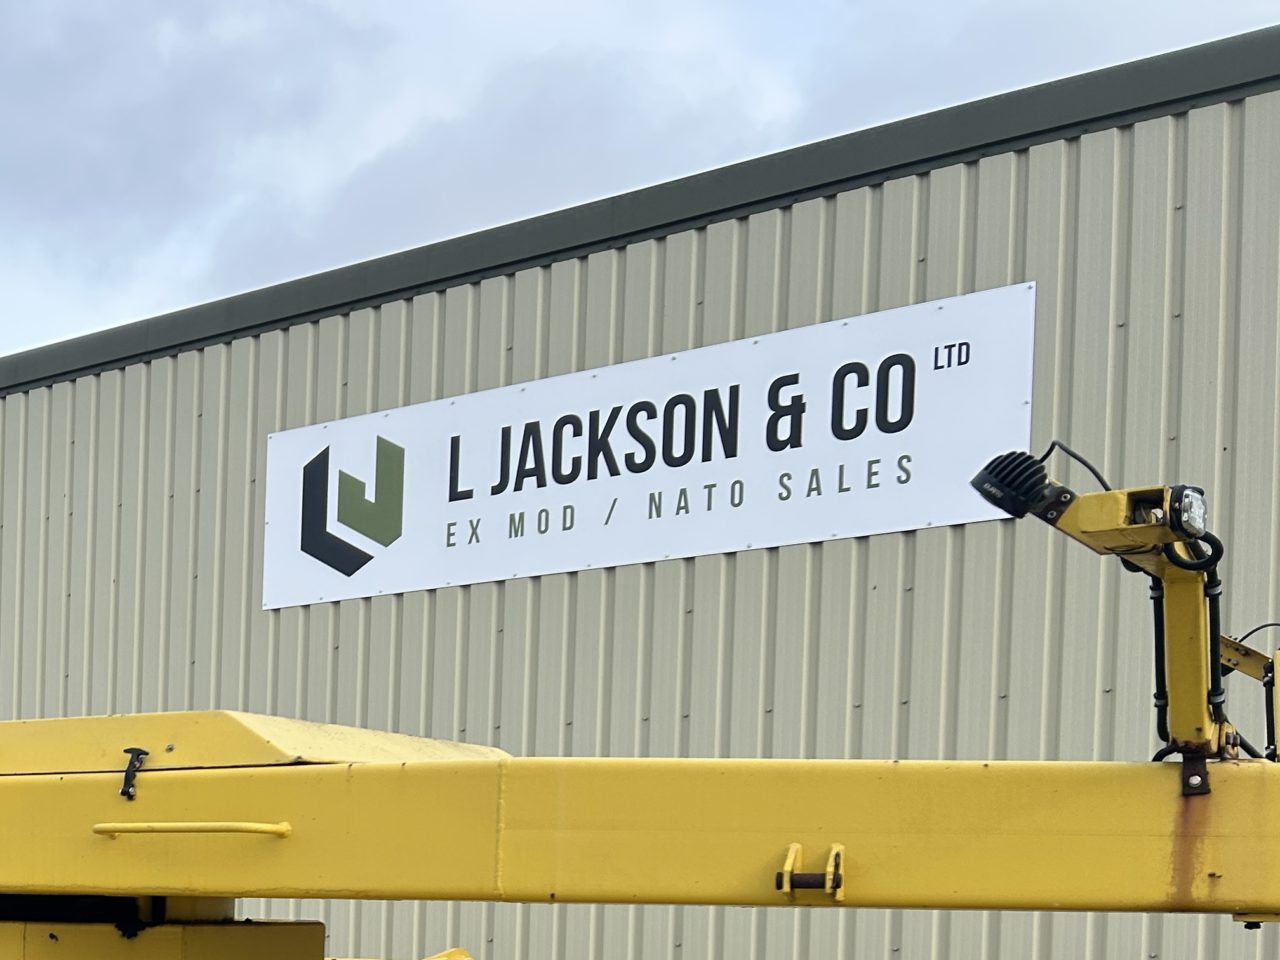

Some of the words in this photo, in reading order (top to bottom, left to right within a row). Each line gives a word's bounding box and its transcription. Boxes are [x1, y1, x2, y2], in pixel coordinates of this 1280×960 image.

[448, 434, 474, 503] L
[489, 383, 741, 498] JACKSON
[765, 372, 807, 453] &
[830, 353, 916, 442] CO
[933, 341, 971, 371] LTD
[445, 518, 481, 548] EX
[508, 504, 576, 539] MOD
[603, 497, 619, 526] /
[647, 479, 745, 520] NATO
[777, 454, 913, 502] SALES
